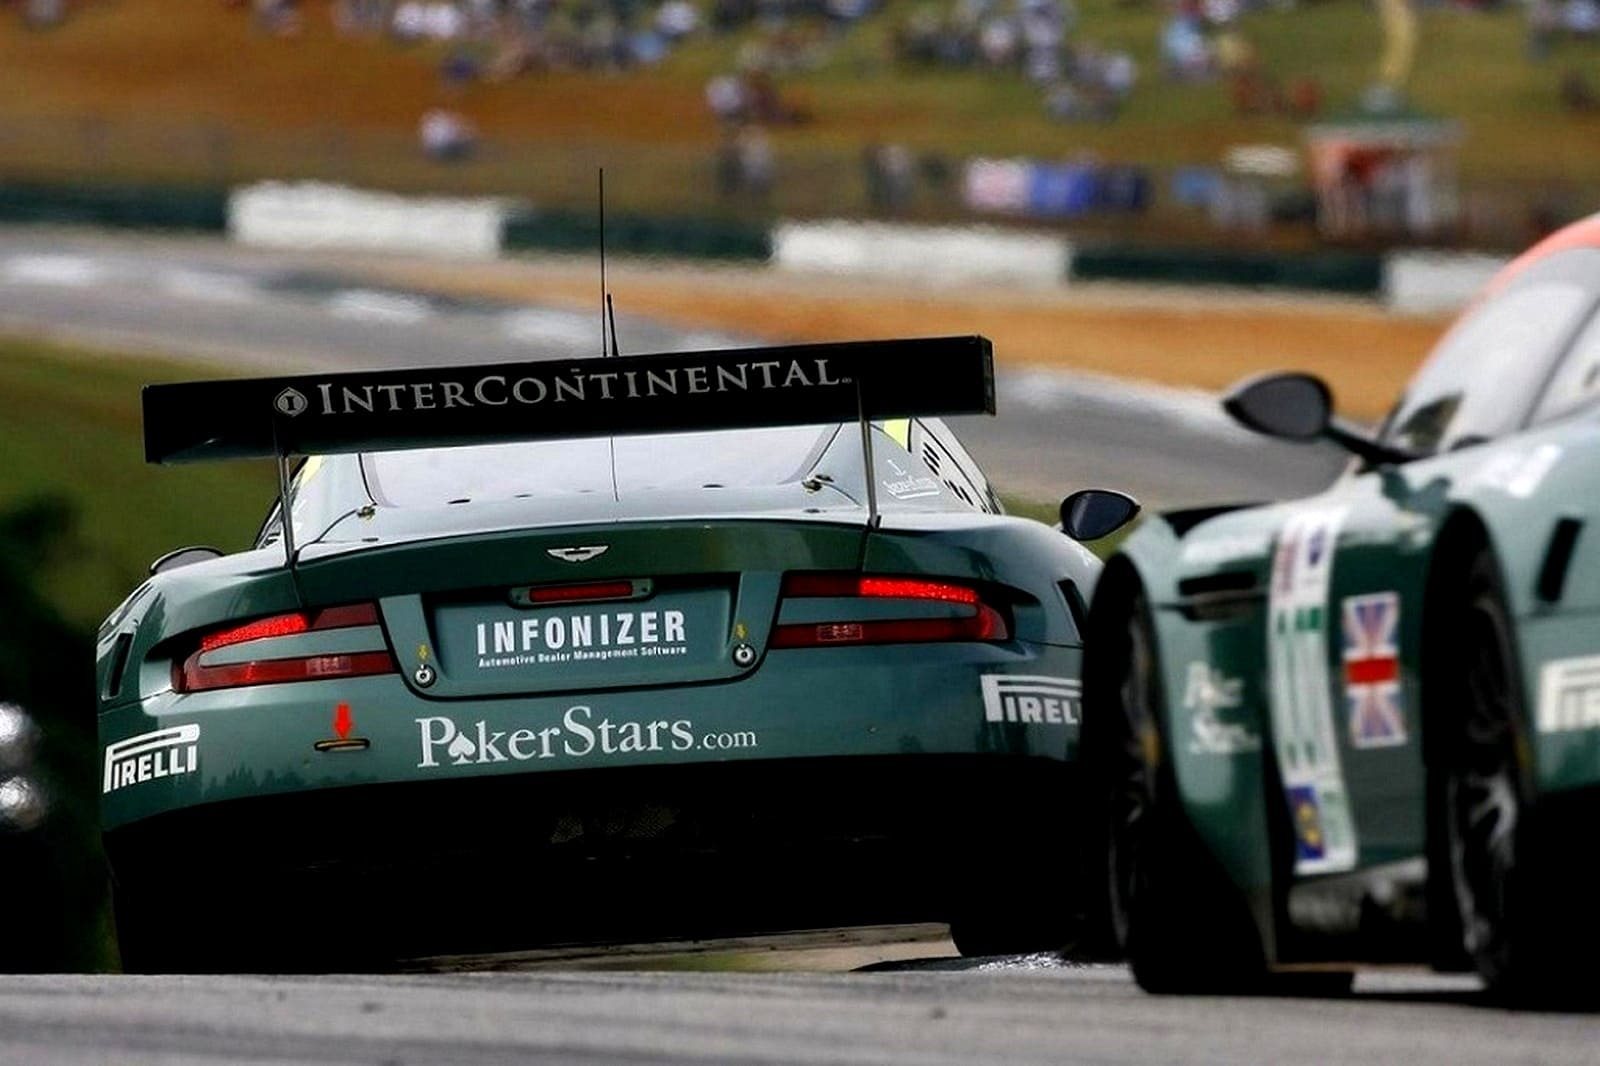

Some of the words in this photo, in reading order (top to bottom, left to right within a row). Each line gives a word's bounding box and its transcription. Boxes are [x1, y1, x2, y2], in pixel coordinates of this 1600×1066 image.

[477, 610, 686, 655] INFONIZER
[478, 653, 536, 668] Automotive
[538, 651, 570, 663] Dealer
[573, 648, 638, 661] Management
[641, 645, 687, 657] Software
[980, 674, 1082, 723] PIREL
[103, 723, 200, 794] PIRELLI
